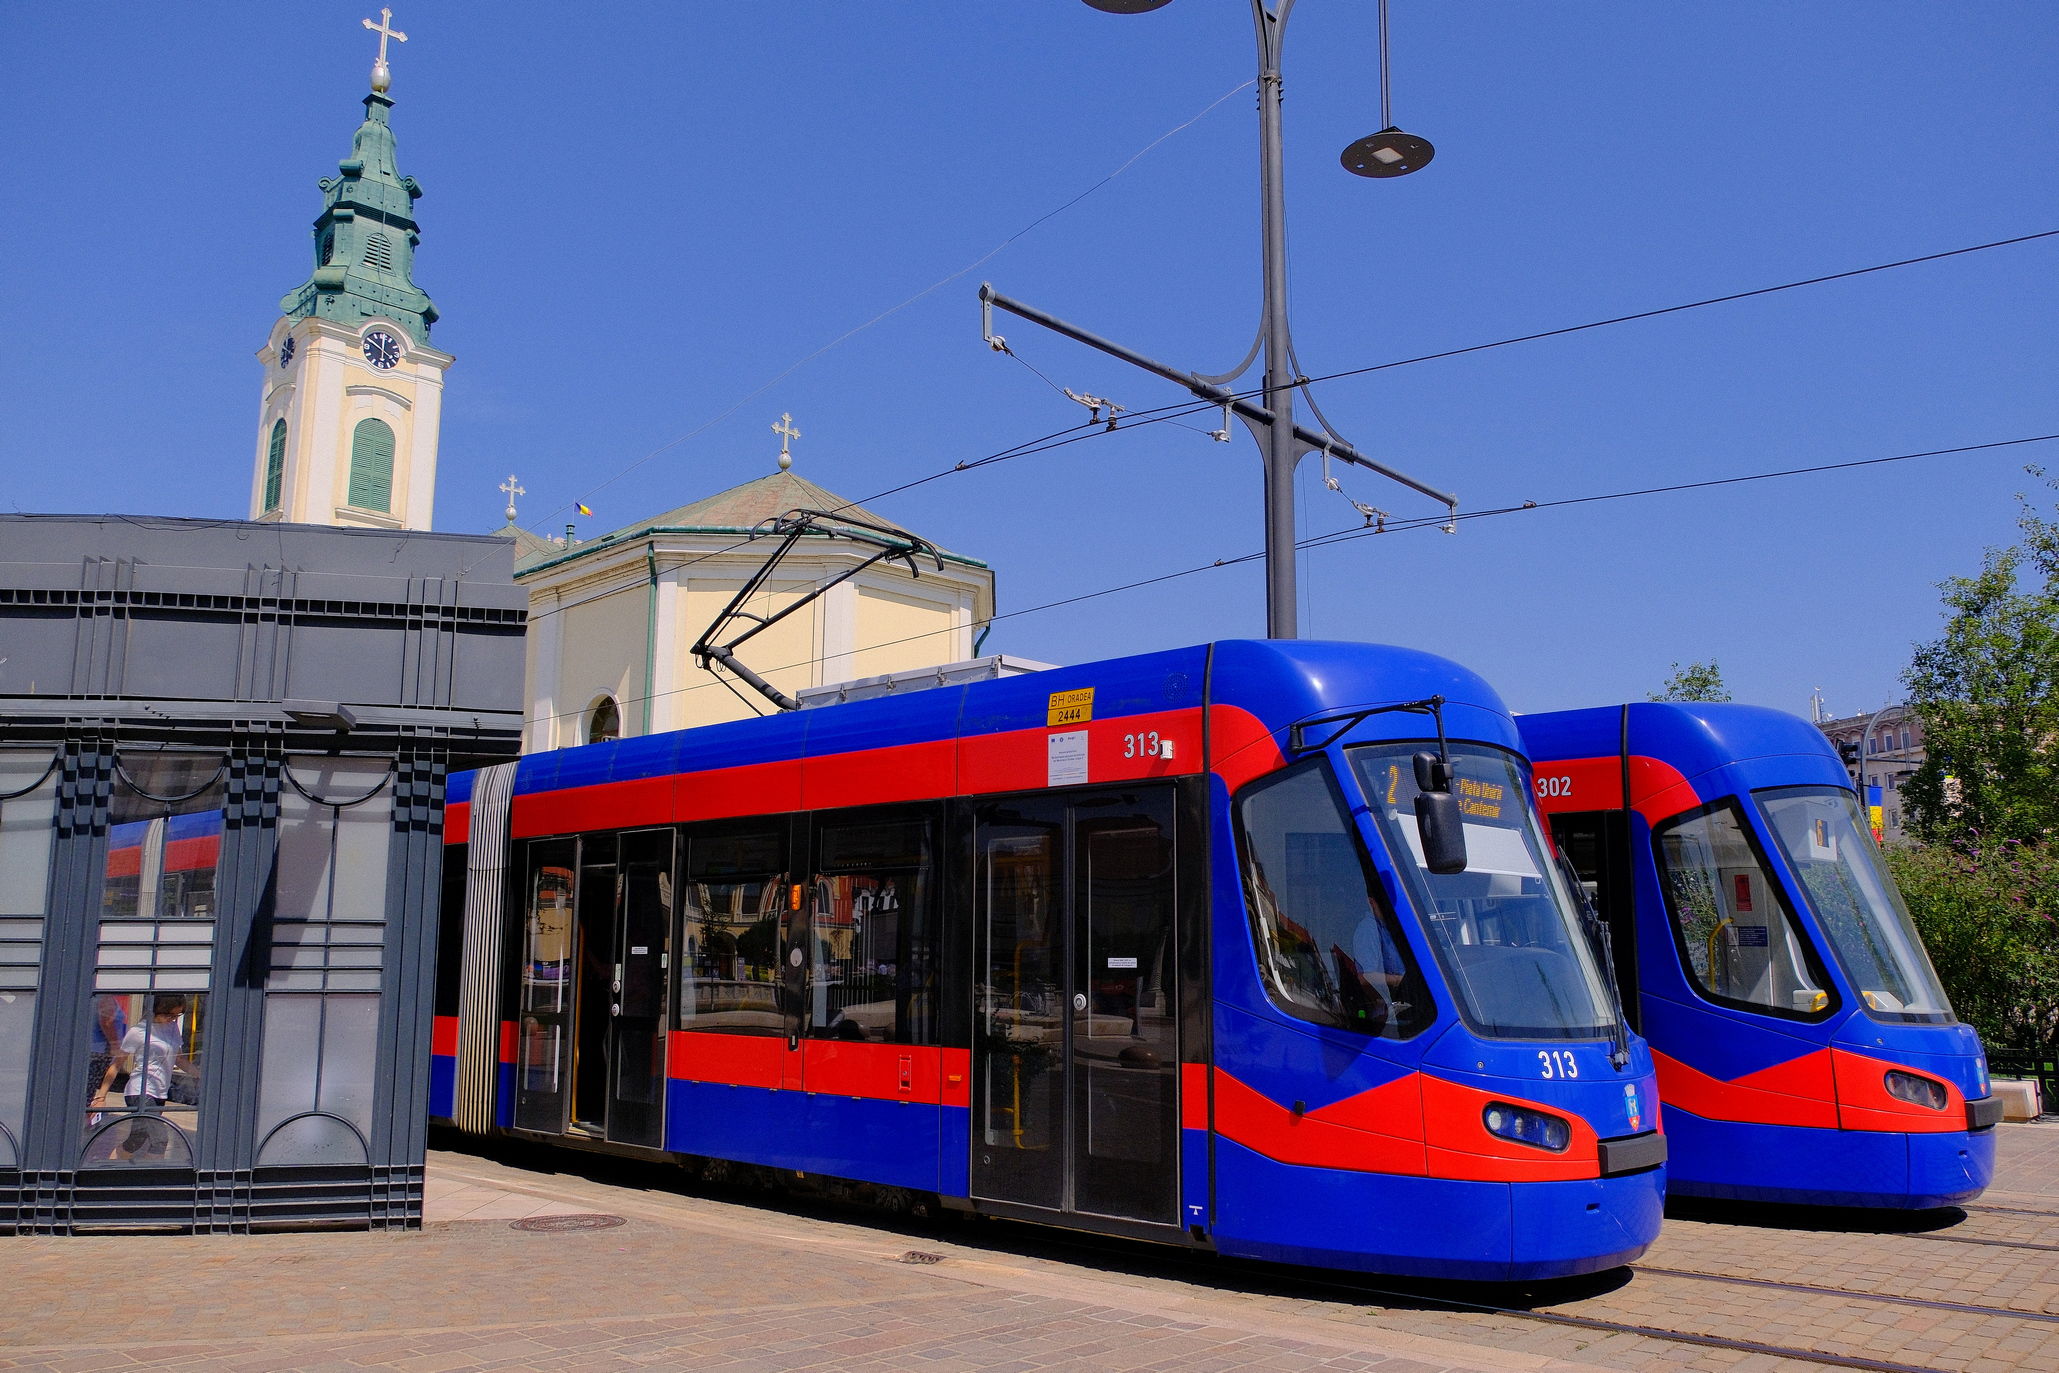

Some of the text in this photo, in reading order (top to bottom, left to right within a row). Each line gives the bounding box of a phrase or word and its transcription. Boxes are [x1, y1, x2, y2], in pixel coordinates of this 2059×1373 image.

[1051, 692, 1091, 708] BH ORADEA
[1058, 708, 1081, 722] 2444
[1124, 731, 1160, 758] 313
[1387, 765, 1398, 804] 2
[1537, 776, 1572, 798] 302
[1538, 1050, 1578, 1079] 313
